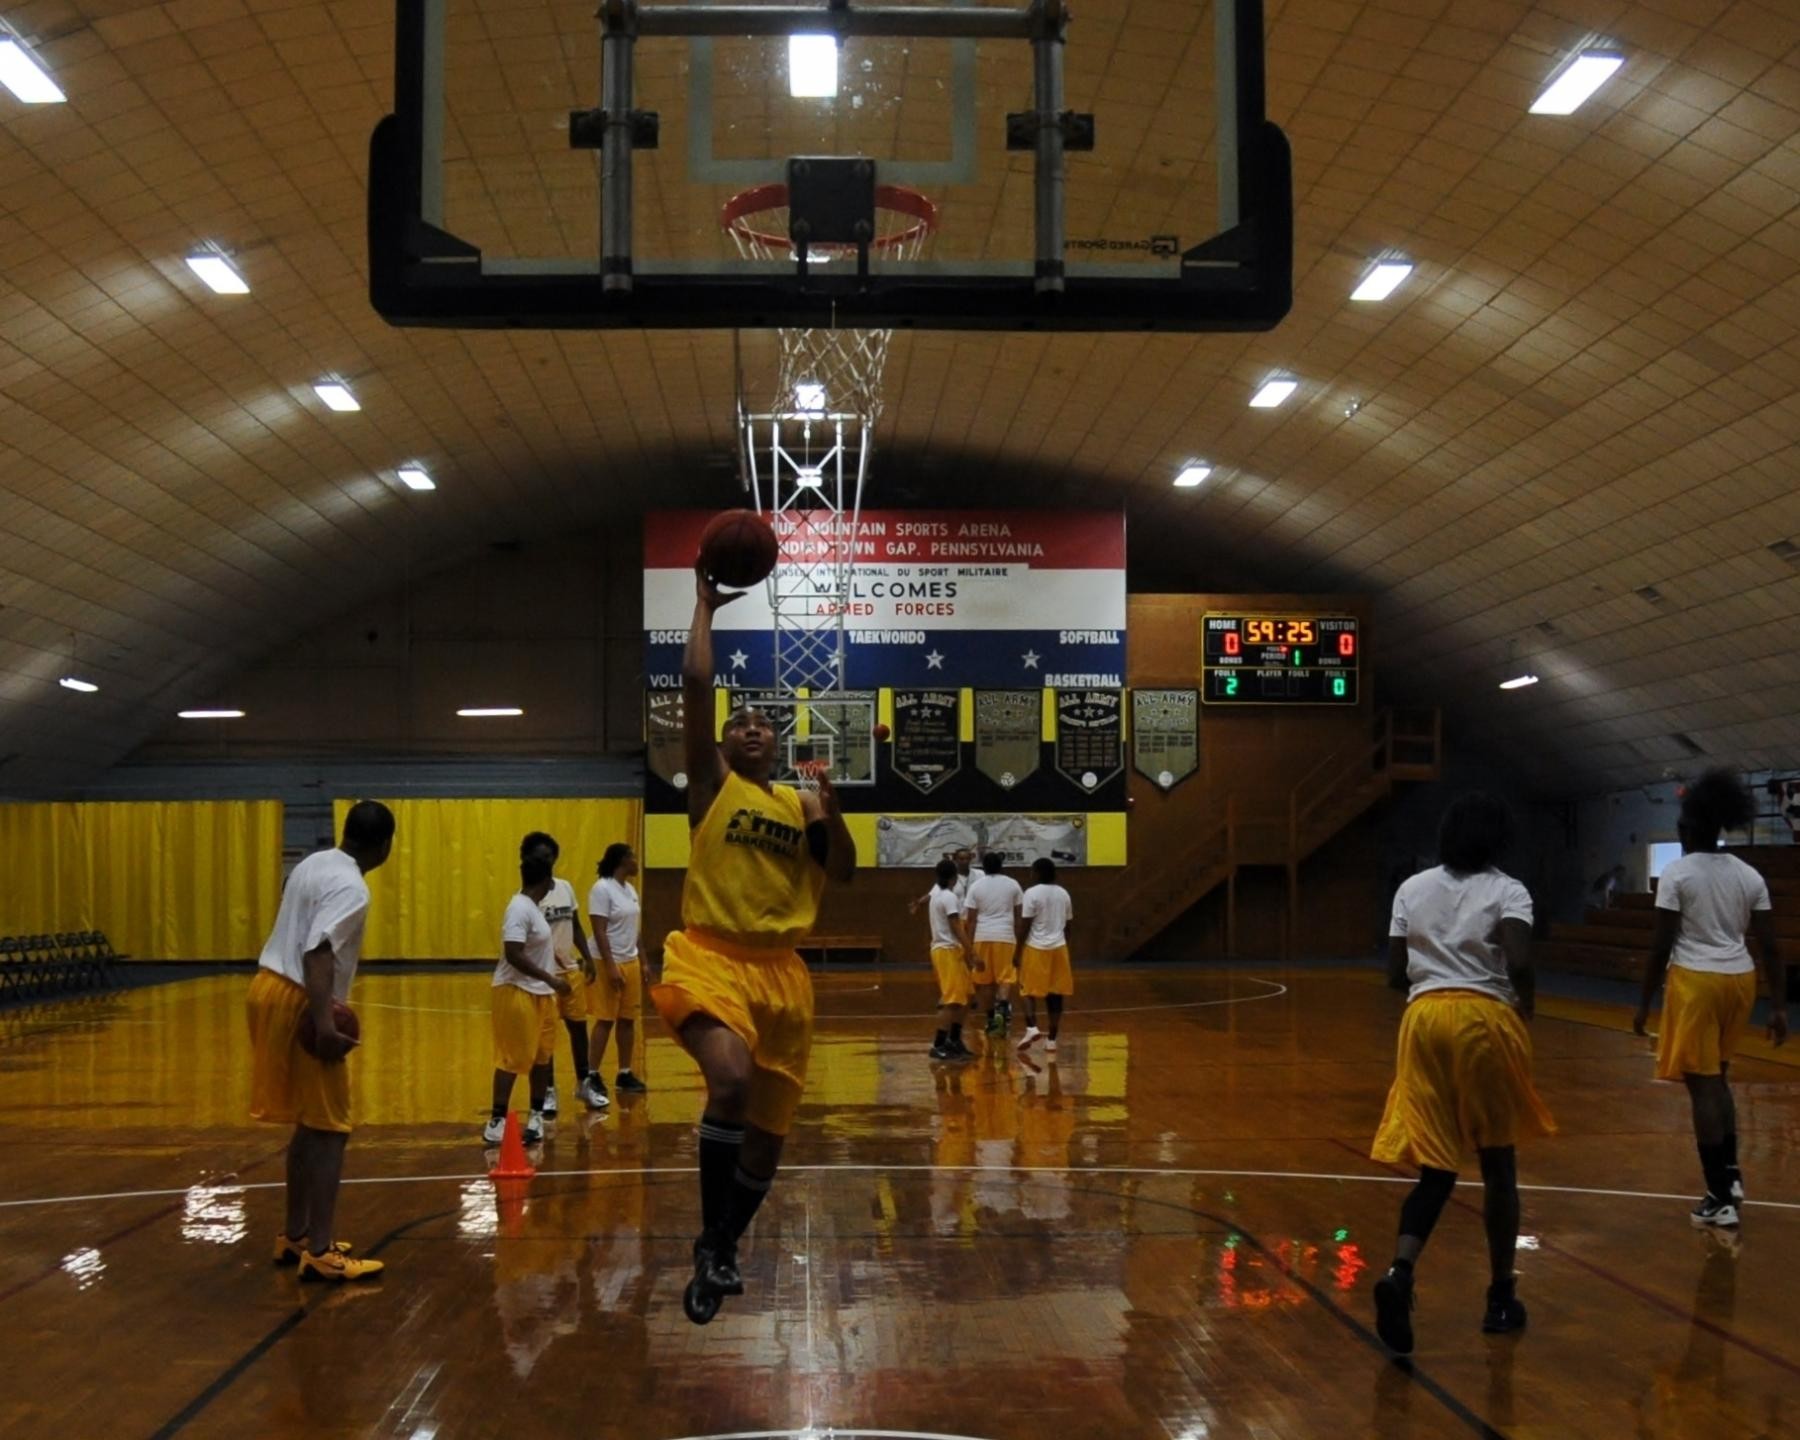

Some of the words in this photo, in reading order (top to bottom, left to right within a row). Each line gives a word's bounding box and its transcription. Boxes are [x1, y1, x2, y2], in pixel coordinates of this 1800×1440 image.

[807, 522, 886, 536] MOUNTAIN
[895, 522, 948, 536] SPORTS
[958, 523, 1012, 537] ARENA
[778, 541, 875, 556] NDIANTOWN
[931, 542, 1044, 557] PENNSYLVANIA
[897, 568, 910, 577] DU
[918, 568, 949, 577] SPORT
[957, 568, 1008, 577] MILITAIRE
[817, 602, 874, 616] ARMED
[895, 603, 955, 616] FORCES
[650, 630, 689, 644] SOCCE
[848, 630, 926, 644] TAEKWONDO
[1059, 630, 1120, 645] SOFTBALL
[1209, 619, 1237, 630] HOME
[1247, 621, 1313, 642] 59:25
[1320, 621, 1355, 631] VISITOR
[1225, 633, 1239, 655] 0
[1340, 634, 1354, 655] 0
[1294, 649, 1300, 666] 1
[1044, 673, 1122, 687] BASKETBALL
[1214, 669, 1237, 677] FOULS
[1256, 669, 1283, 677] PLAYER
[1288, 669, 1310, 677] FOULS
[1226, 677, 1239, 695] 2
[1333, 678, 1345, 695] 0
